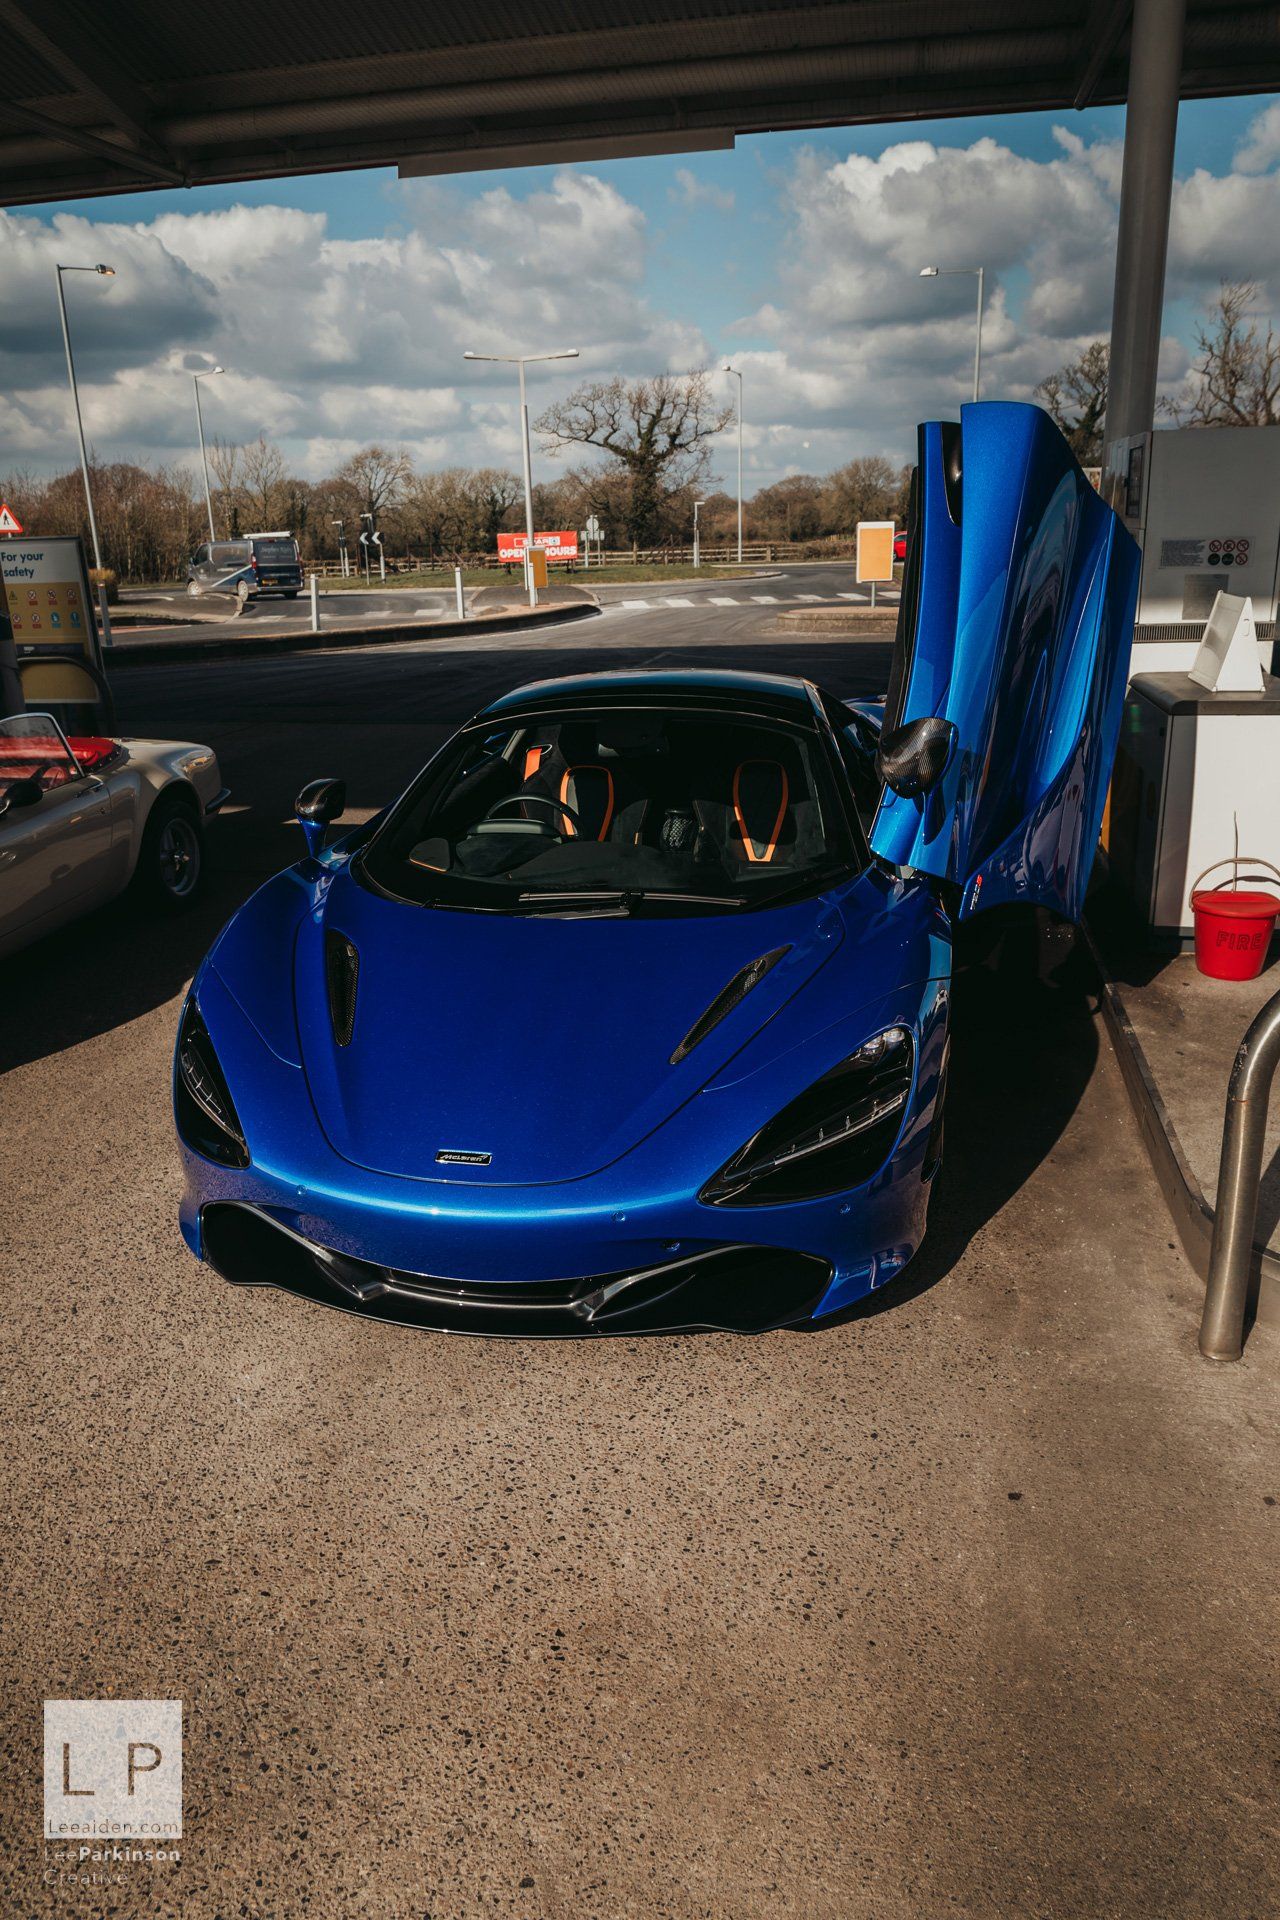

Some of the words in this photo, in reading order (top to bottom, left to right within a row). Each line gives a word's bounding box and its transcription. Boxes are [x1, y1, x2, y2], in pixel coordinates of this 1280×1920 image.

[1, 552, 17, 561] For
[20, 552, 44, 563] your
[4, 566, 34, 578] safety
[1216, 930, 1262, 950] FIRE
[440, 1154, 484, 1162] McLaren
